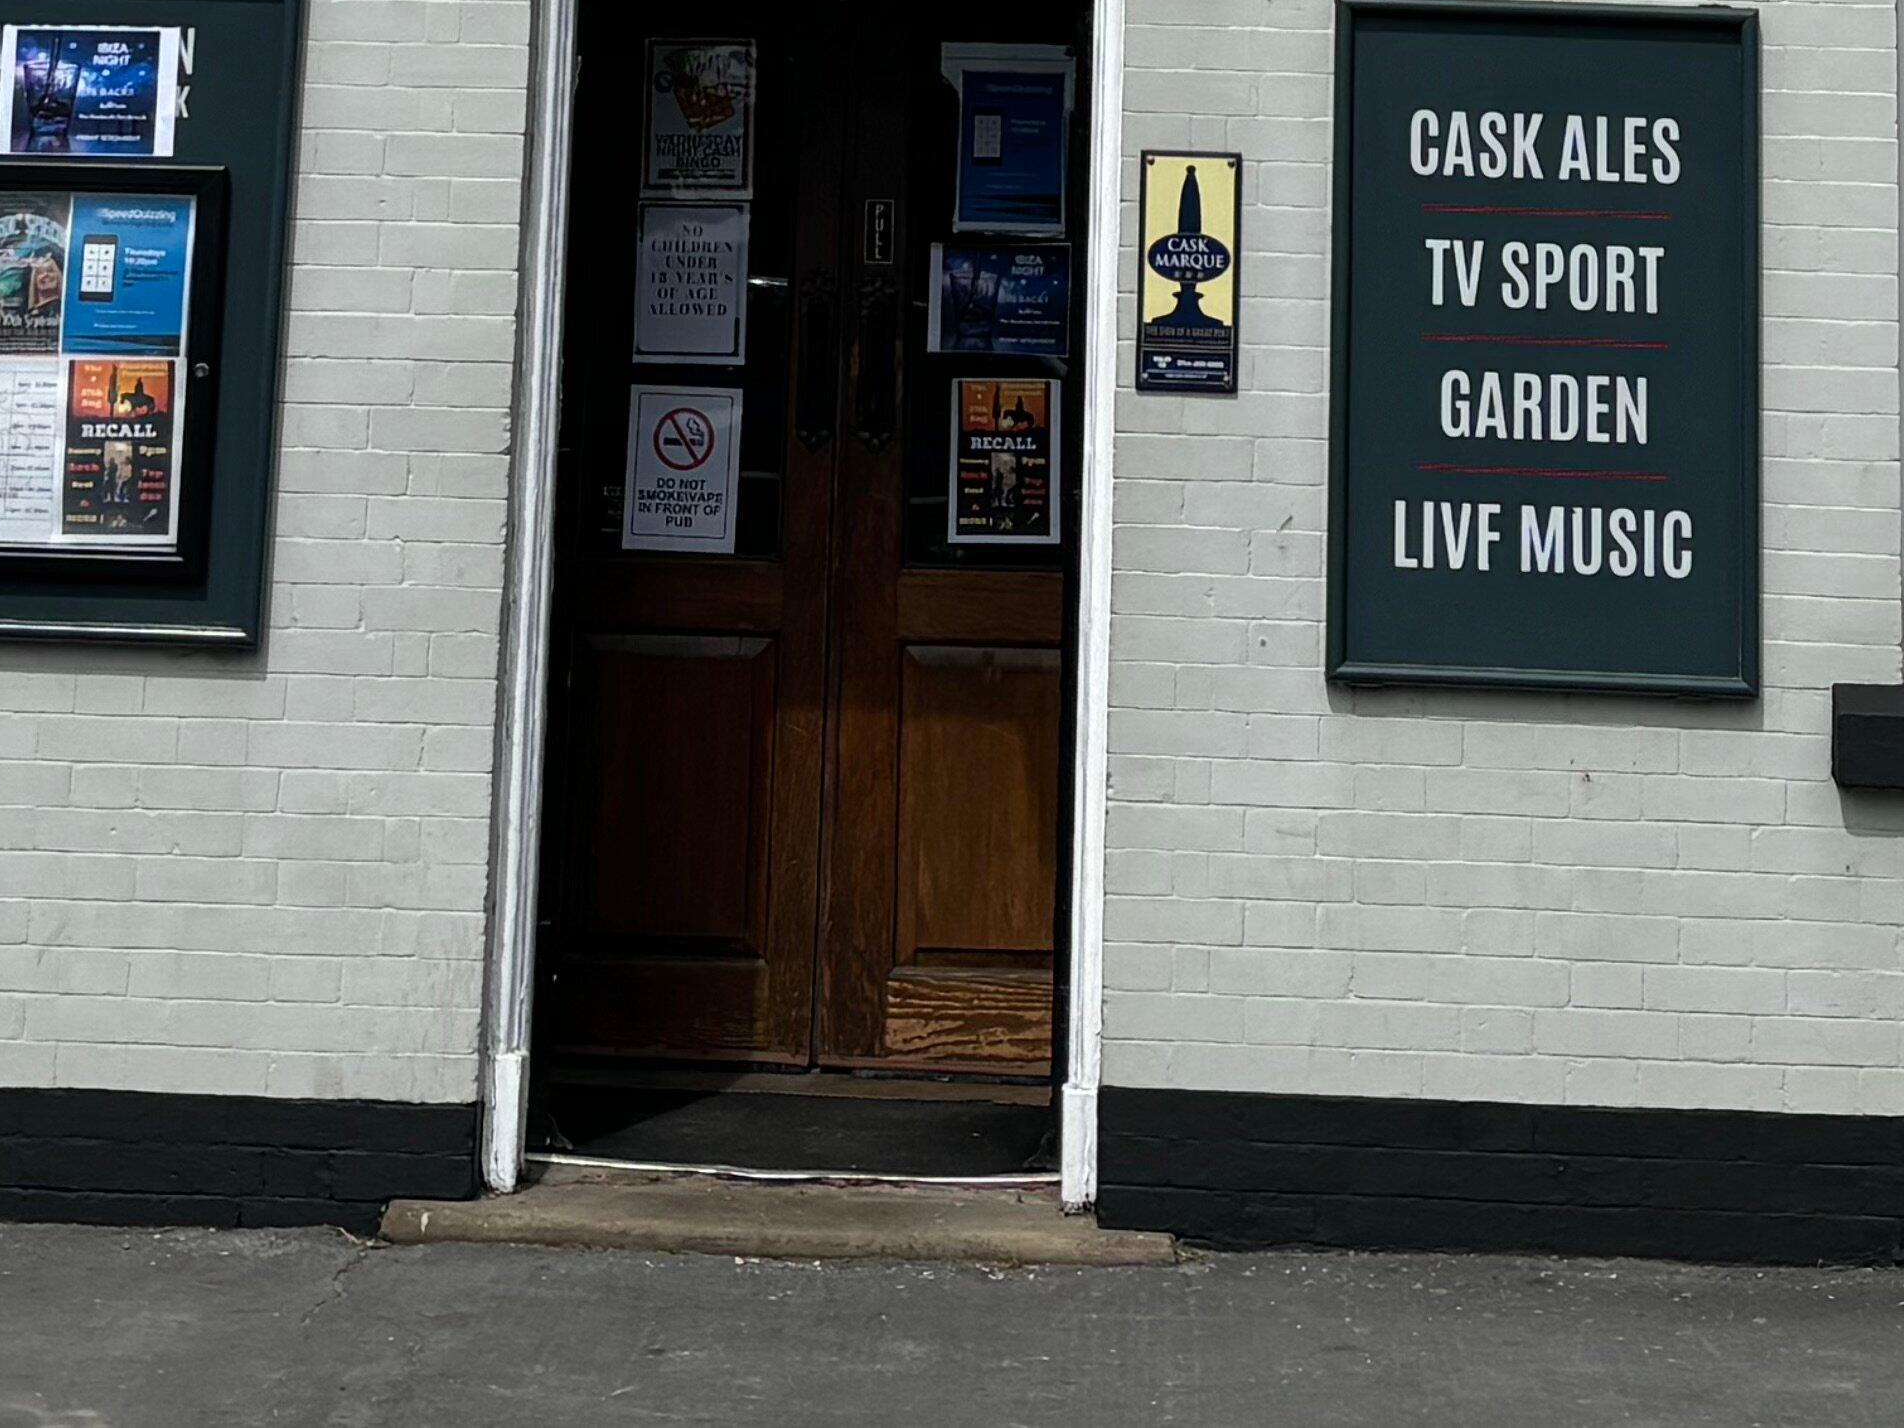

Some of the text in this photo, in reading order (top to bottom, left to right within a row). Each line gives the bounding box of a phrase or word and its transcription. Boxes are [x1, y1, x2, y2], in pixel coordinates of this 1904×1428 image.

[93, 55, 132, 66] NIGHT
[1410, 109, 1681, 185] CASK ALES
[675, 157, 721, 168] BINGO
[682, 224, 703, 237] NO
[875, 204, 884, 259] PULL
[651, 240, 733, 253] CHILDREN
[1167, 238, 1210, 253] CASK
[665, 256, 717, 269] UNDER
[1155, 253, 1225, 270] MARQUE
[1425, 239, 1665, 314] TV SPORT
[657, 287, 719, 300] OF AGE
[649, 303, 728, 316] ALLOWED
[1440, 370, 1648, 445] GARDEN
[81, 424, 157, 438] RECALL
[970, 437, 1037, 450] RECALL
[656, 477, 706, 490] DO NOT
[638, 502, 721, 516] IN FRONT OF
[1520, 504, 1693, 579] MUSIC
